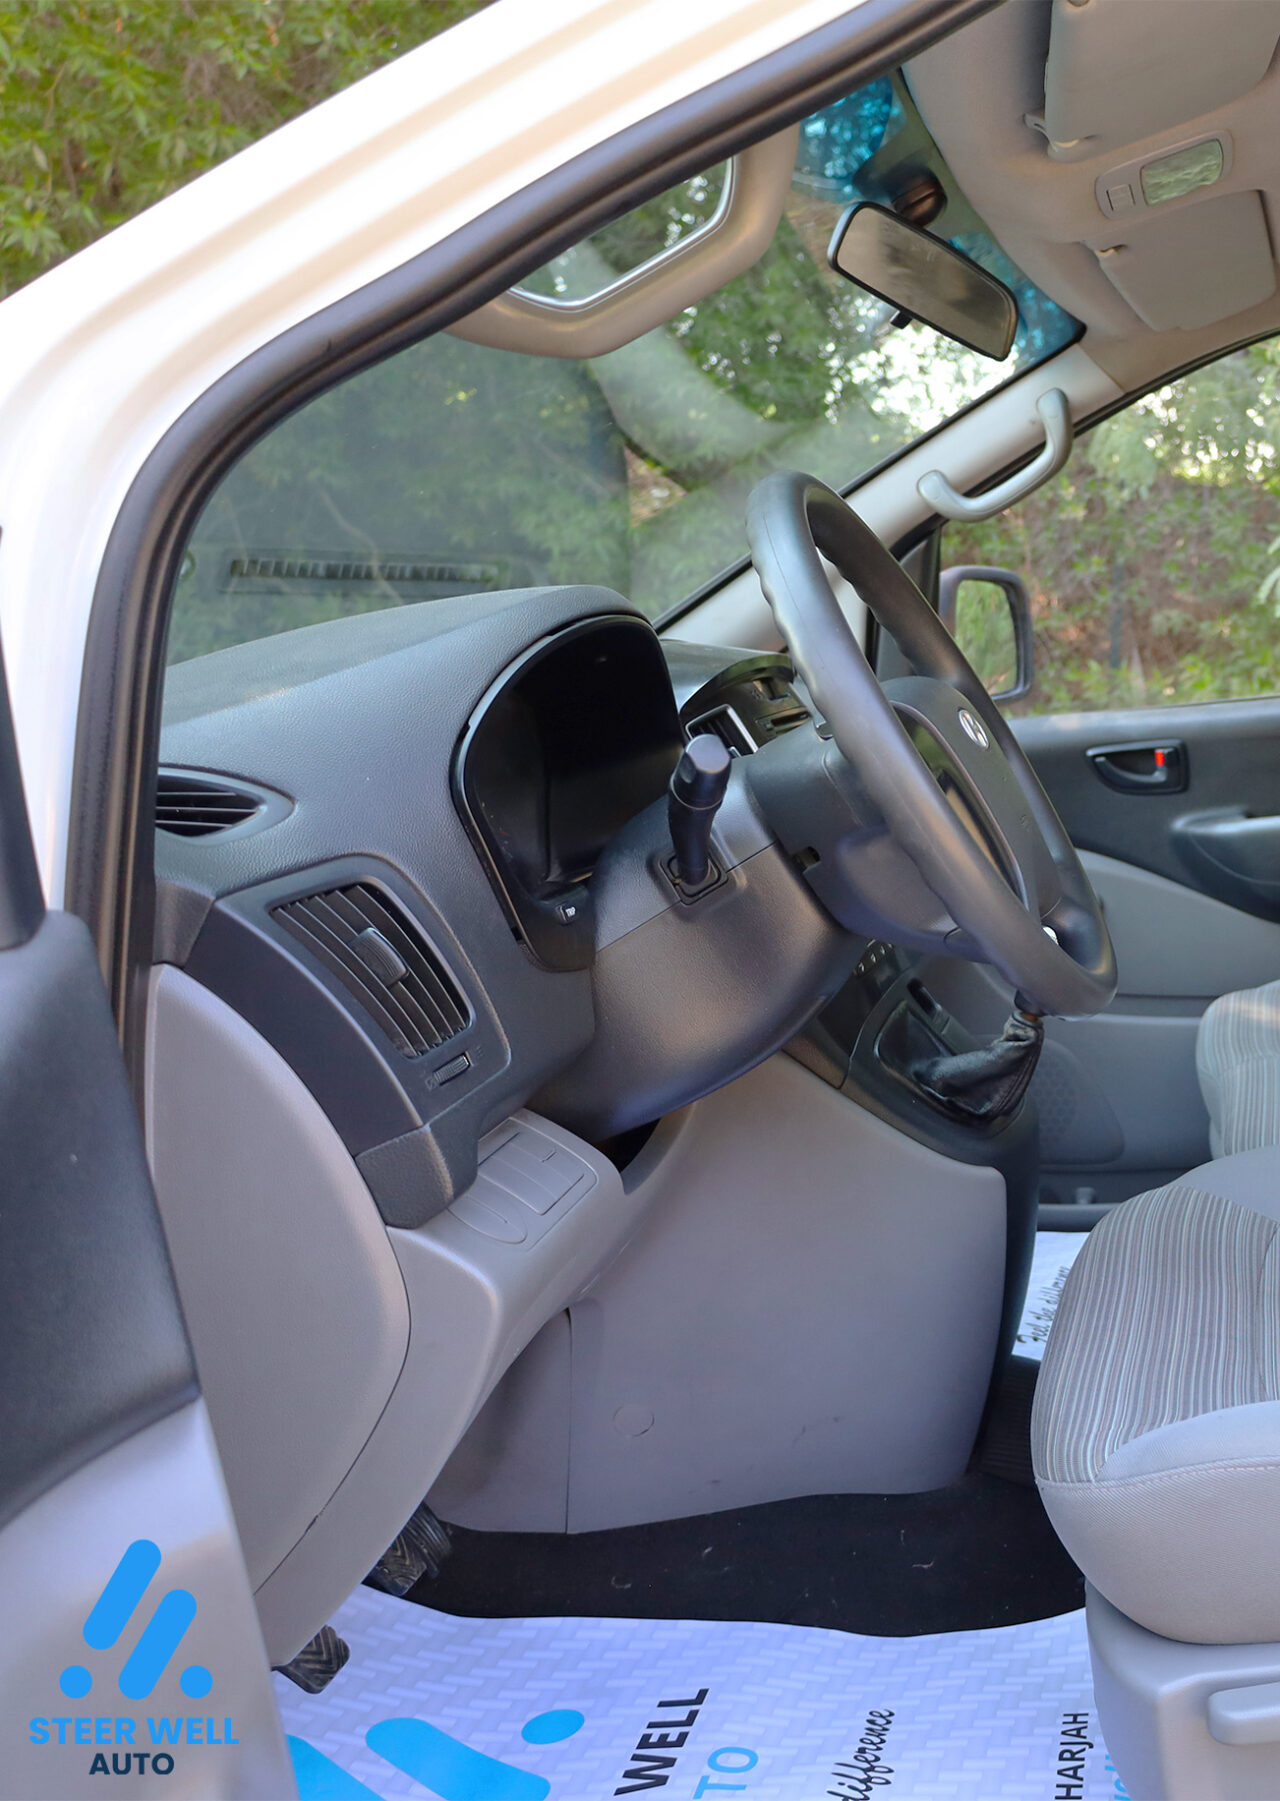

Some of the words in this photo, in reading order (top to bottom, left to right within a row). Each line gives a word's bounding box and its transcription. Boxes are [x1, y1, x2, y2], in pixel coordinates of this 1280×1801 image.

[613, 1688, 710, 1796] WELL
[692, 1746, 759, 1800] TO
[826, 1708, 895, 1801] difference
[1054, 1712, 1094, 1801] HARJAH
